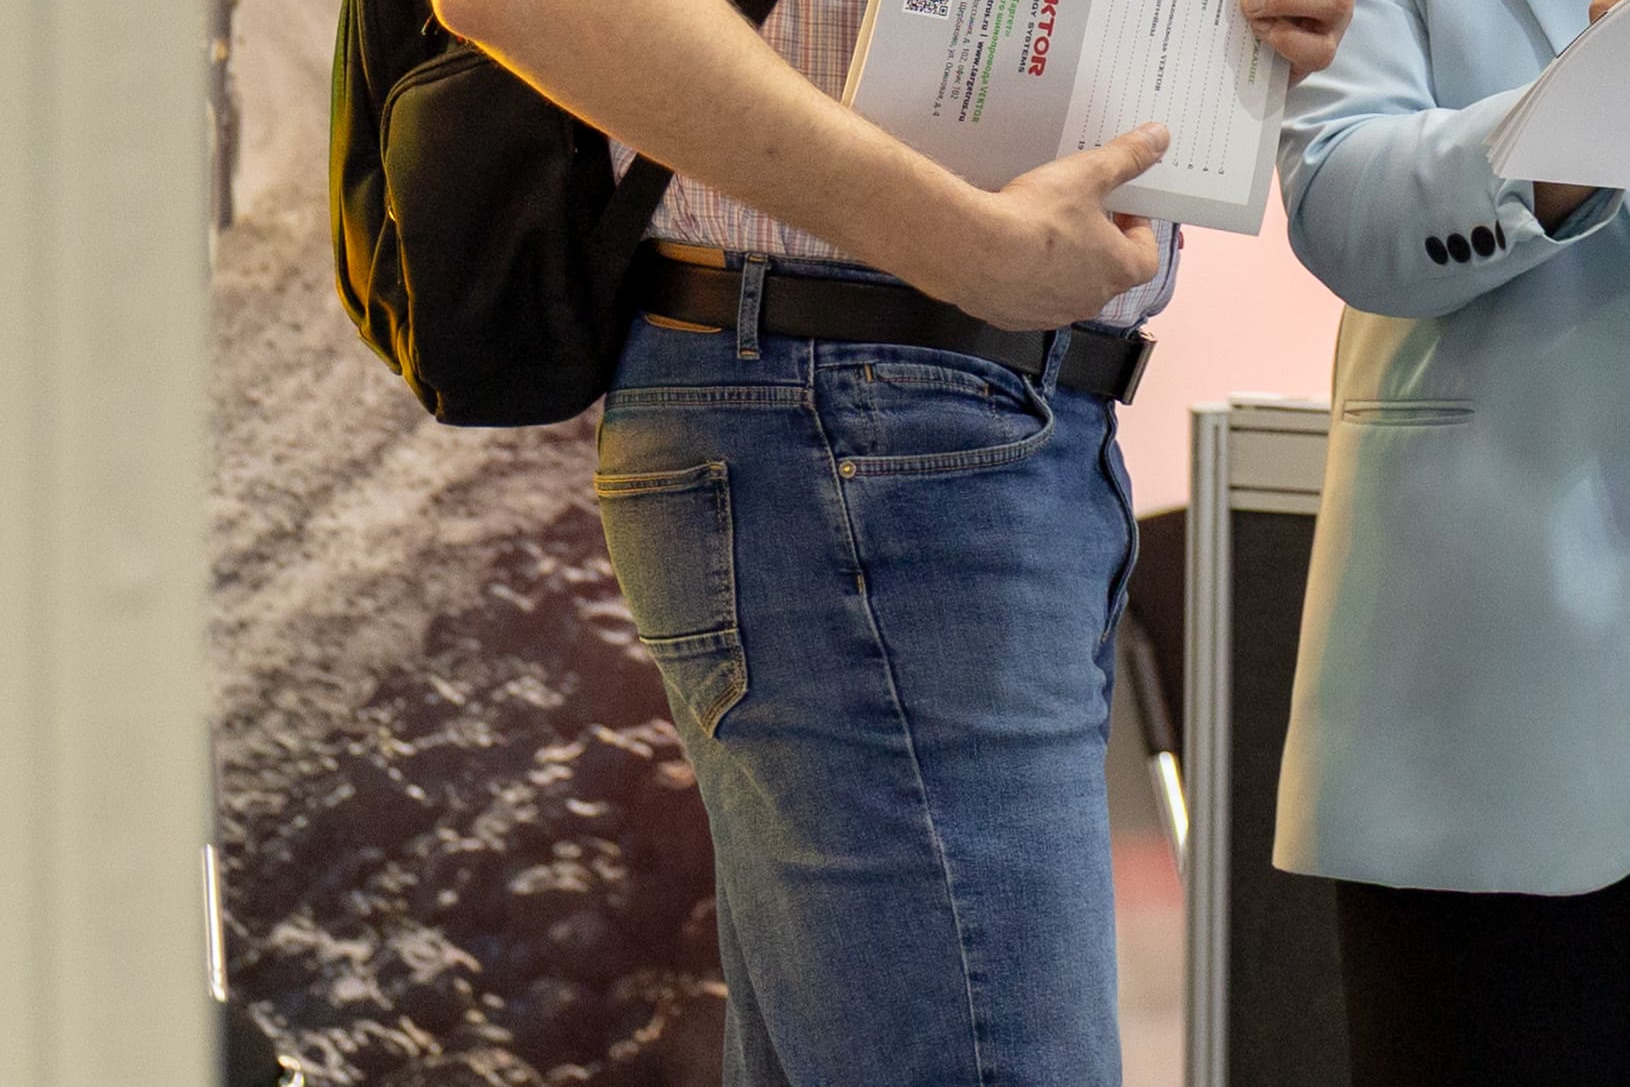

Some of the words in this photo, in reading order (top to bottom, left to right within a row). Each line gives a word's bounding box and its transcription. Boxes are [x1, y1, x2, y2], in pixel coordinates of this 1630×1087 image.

[980, 12, 1002, 84] шинопровода
[1017, 21, 1034, 73] SYSTEMS
[949, 86, 961, 100] 102
[958, 41, 983, 122] www.targetrus.ru
[971, 86, 987, 123] VEKTOR
[1077, 140, 1085, 150] 19
